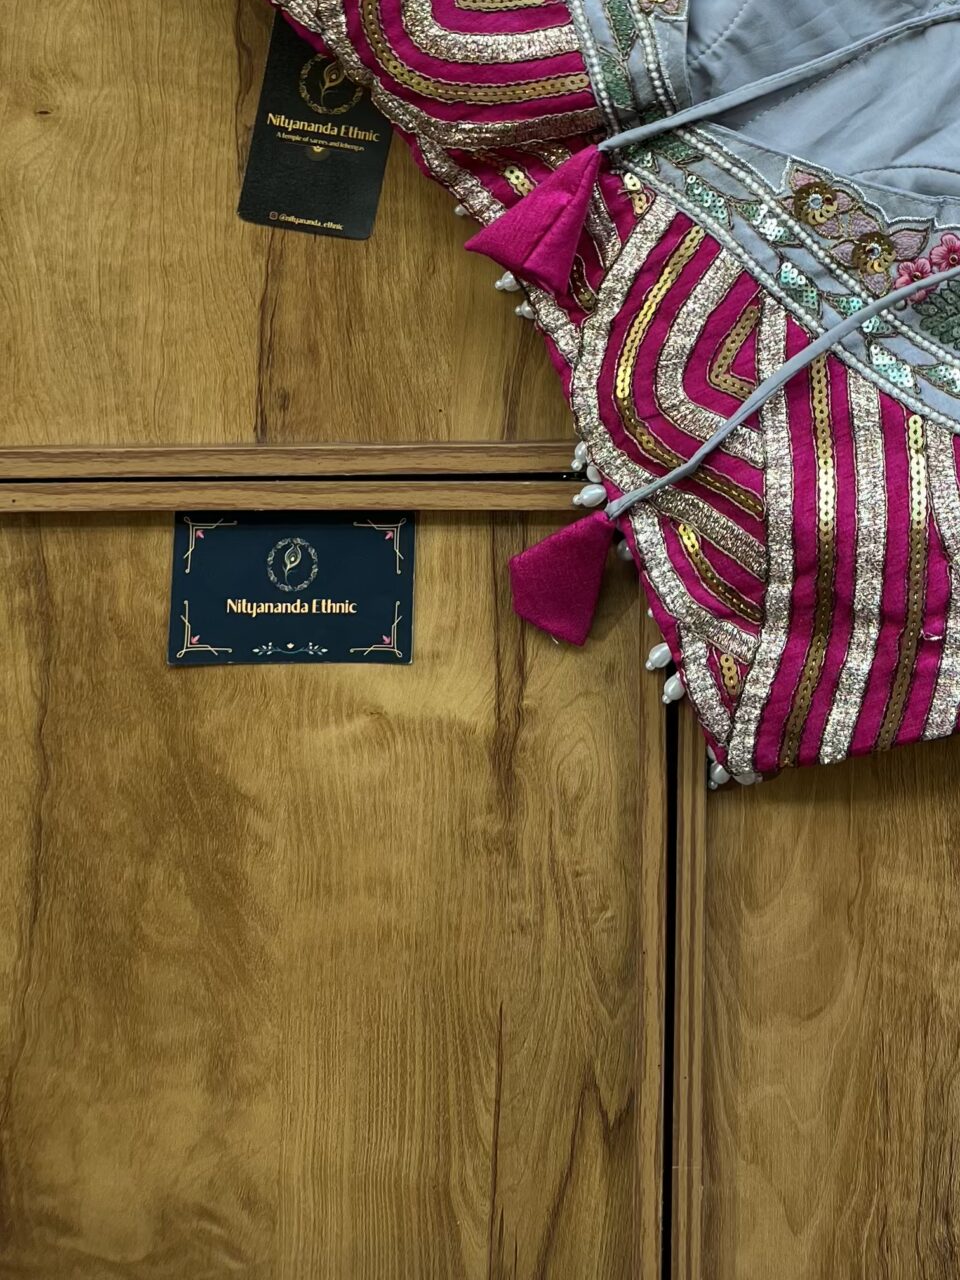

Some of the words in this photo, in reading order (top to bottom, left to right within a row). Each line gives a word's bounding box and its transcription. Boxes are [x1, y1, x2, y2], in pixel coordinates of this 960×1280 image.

[267, 113, 338, 135] Nityananda
[340, 125, 380, 142] Ethnic
[226, 598, 309, 617] Nityananda
[312, 598, 357, 614] Ethnic
